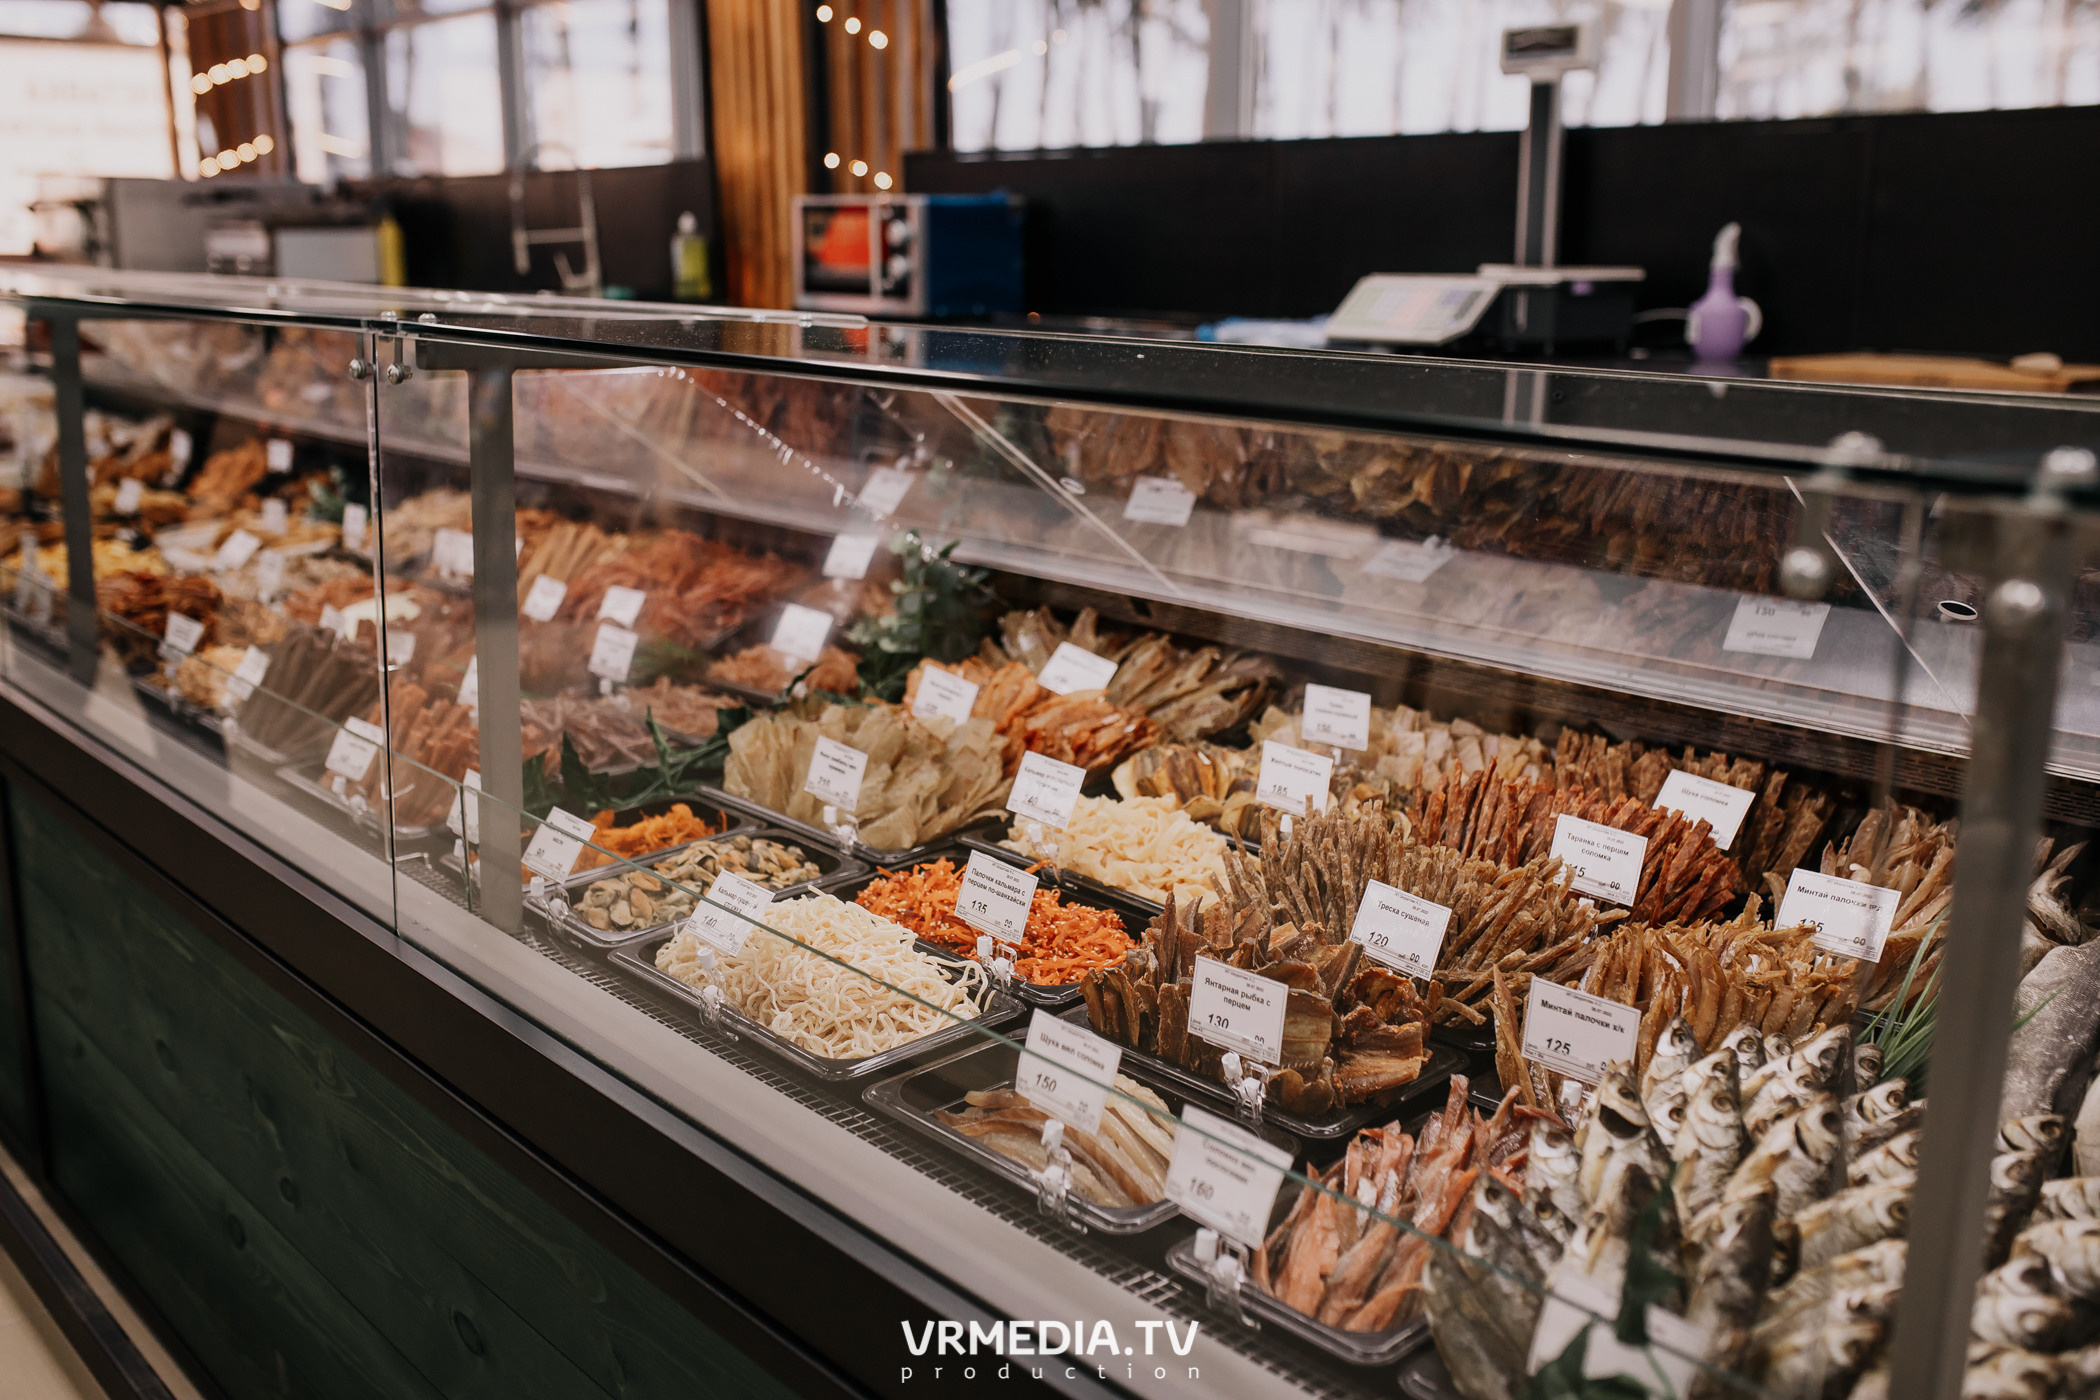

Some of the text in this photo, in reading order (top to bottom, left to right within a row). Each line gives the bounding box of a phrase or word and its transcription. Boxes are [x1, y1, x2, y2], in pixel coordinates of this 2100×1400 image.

[1567, 832, 1595, 847] Таранка
[1602, 844, 1630, 857] перцем
[1581, 848, 1612, 862] соломка
[967, 877, 1026, 908] перцем по-шанхайски
[971, 867, 995, 882] Палочки
[995, 878, 1021, 896] кальмара
[1610, 881, 1621, 890] 00
[718, 886, 738, 900] Кальмар
[1796, 885, 1829, 899] Минтай
[1830, 894, 1867, 910] палочки
[971, 900, 988, 914] 135
[1377, 900, 1430, 928] Треска сушеная
[704, 915, 718, 928] 140
[1368, 931, 1389, 948] 120
[1409, 952, 1420, 963] 00
[1852, 936, 1866, 946] 00
[1204, 977, 1240, 996] Янтарная
[1240, 990, 1265, 1005] рыбка
[1224, 996, 1251, 1011] перцем
[1208, 1013, 1230, 1030] 130
[1541, 998, 1625, 1034] Минтай палочки х/к
[1040, 1032, 1060, 1049] Щука
[1077, 1050, 1105, 1072] соломка
[1546, 1038, 1571, 1055] 125
[1036, 1072, 1058, 1093] 150
[1190, 1178, 1216, 1201] 160
